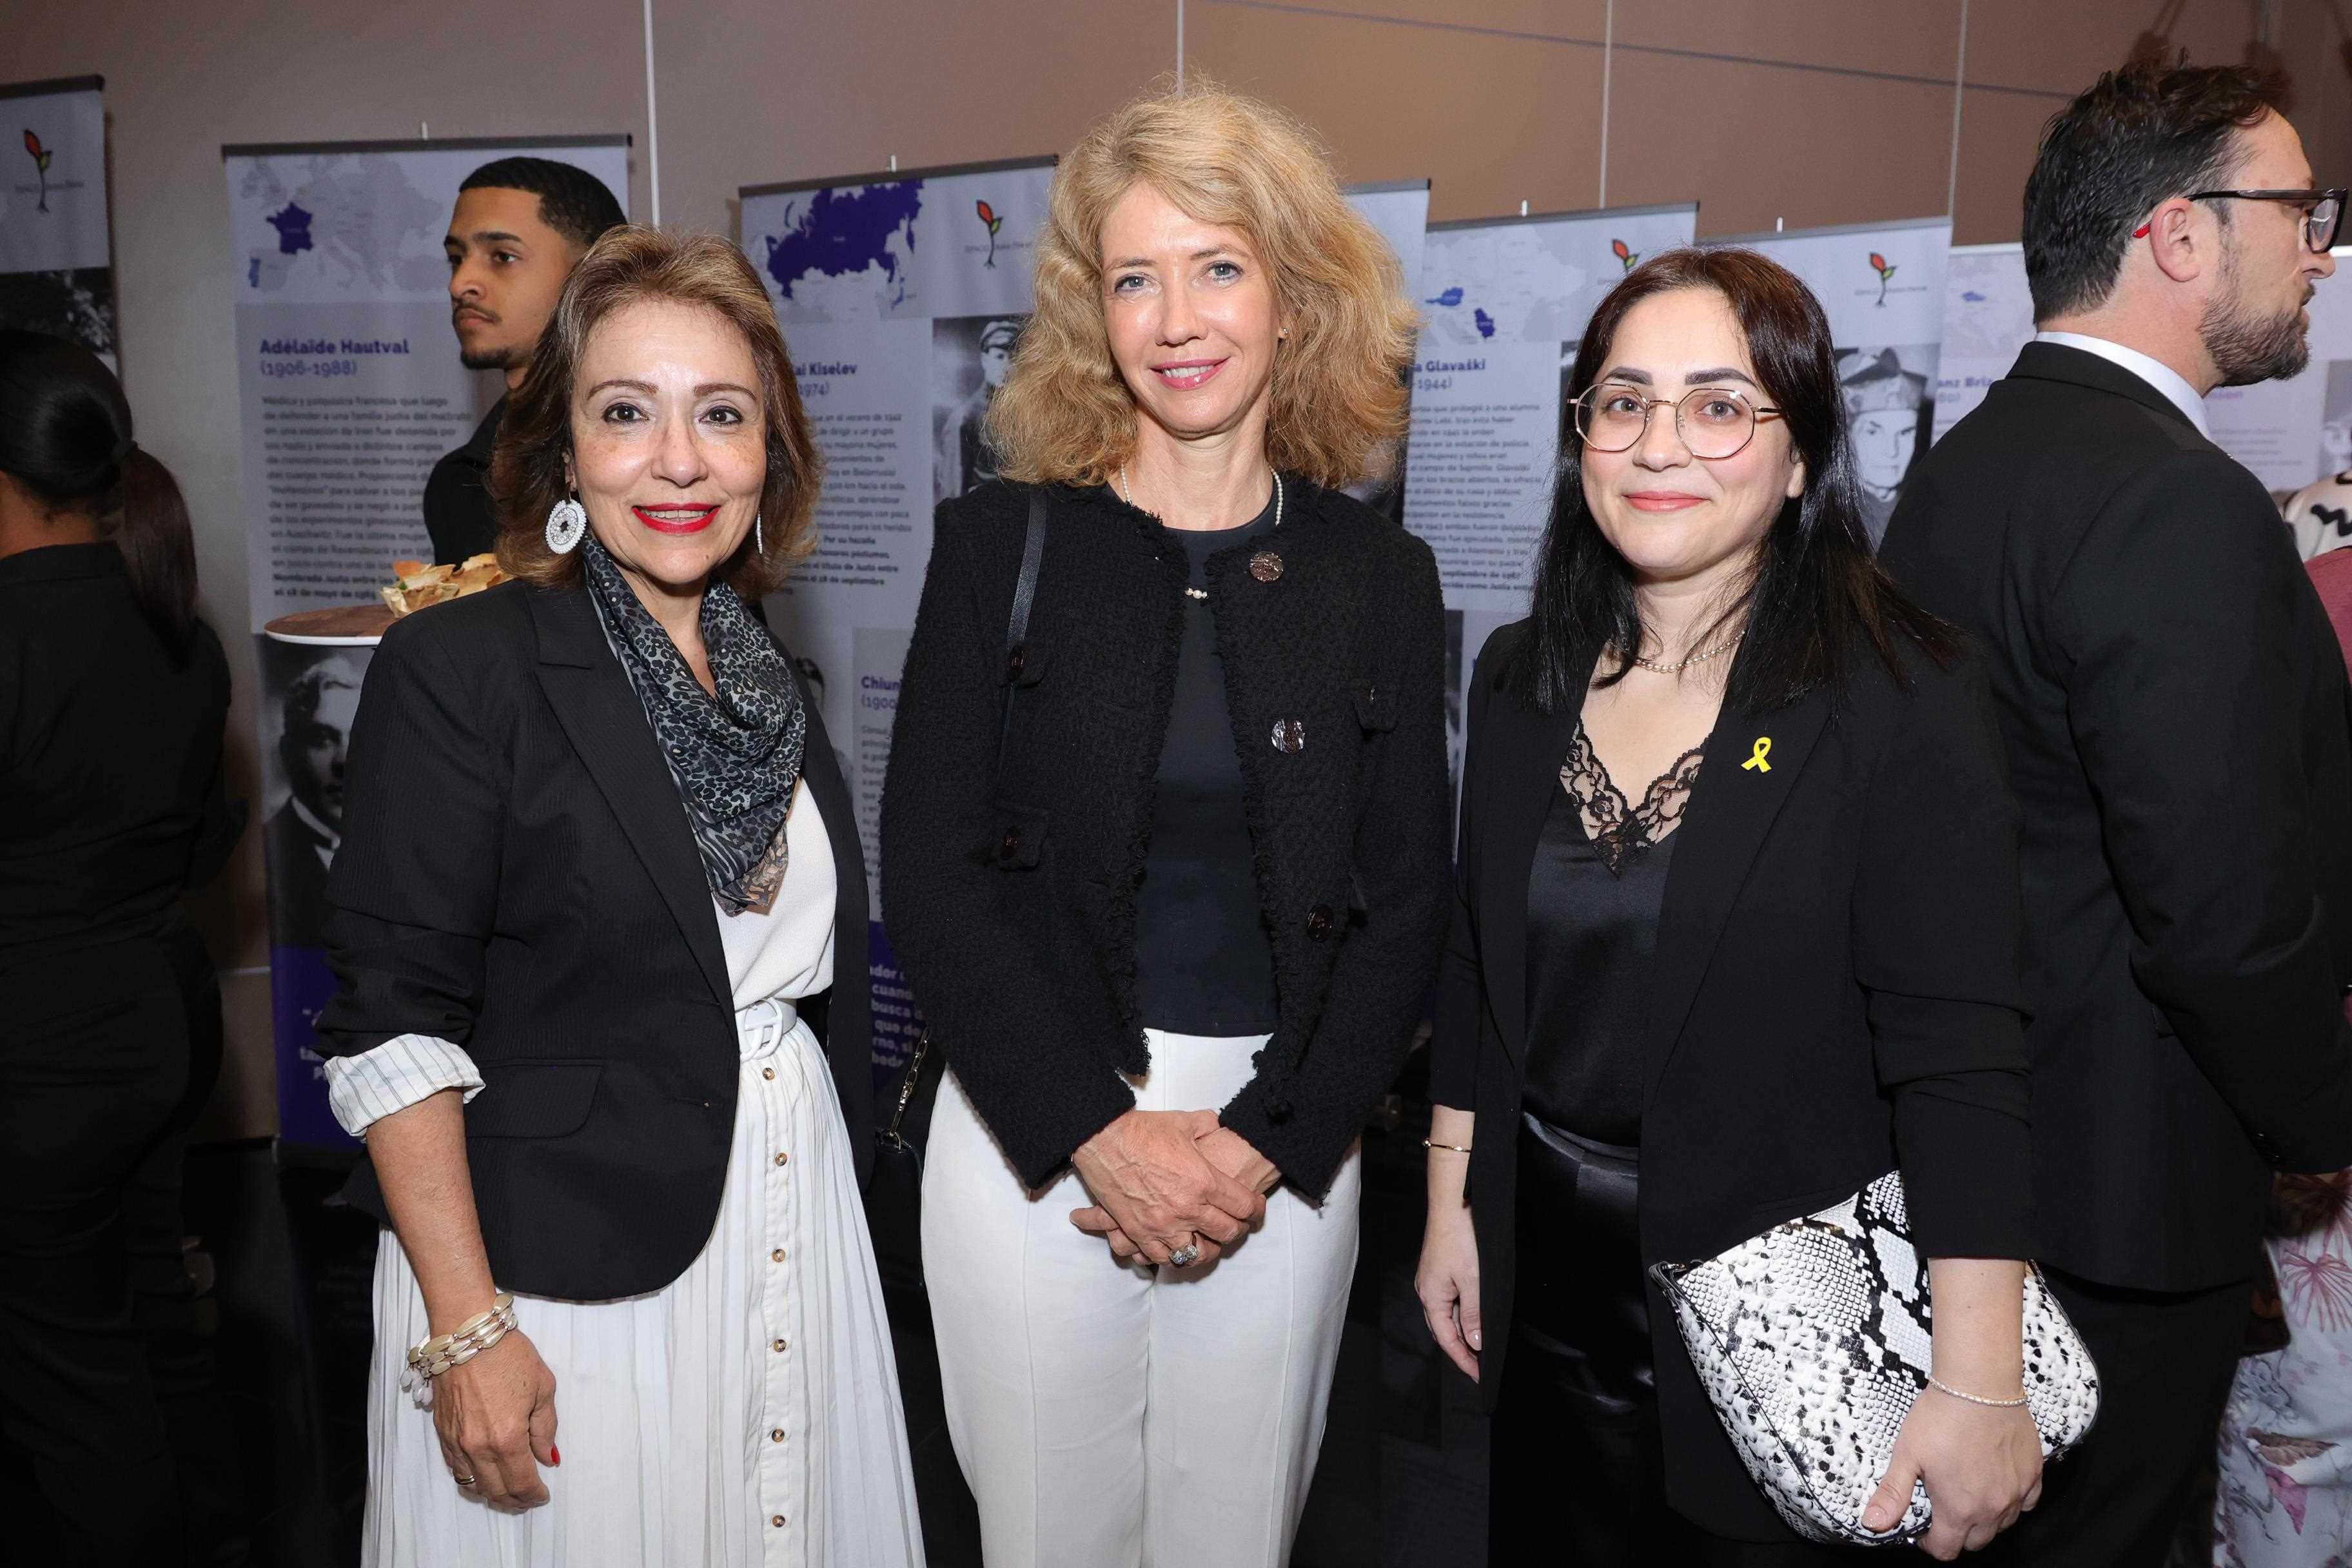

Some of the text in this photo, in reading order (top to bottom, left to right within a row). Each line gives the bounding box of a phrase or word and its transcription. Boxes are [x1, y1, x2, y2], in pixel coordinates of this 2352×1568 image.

[260, 338, 409, 355] Adélaïde Hautval
[809, 361, 858, 375] Kiselev
[1426, 358, 1486, 373] Glavaški
[861, 676, 901, 691] Chiun
[871, 998, 911, 1017] busca
[874, 1019, 901, 1034] que
